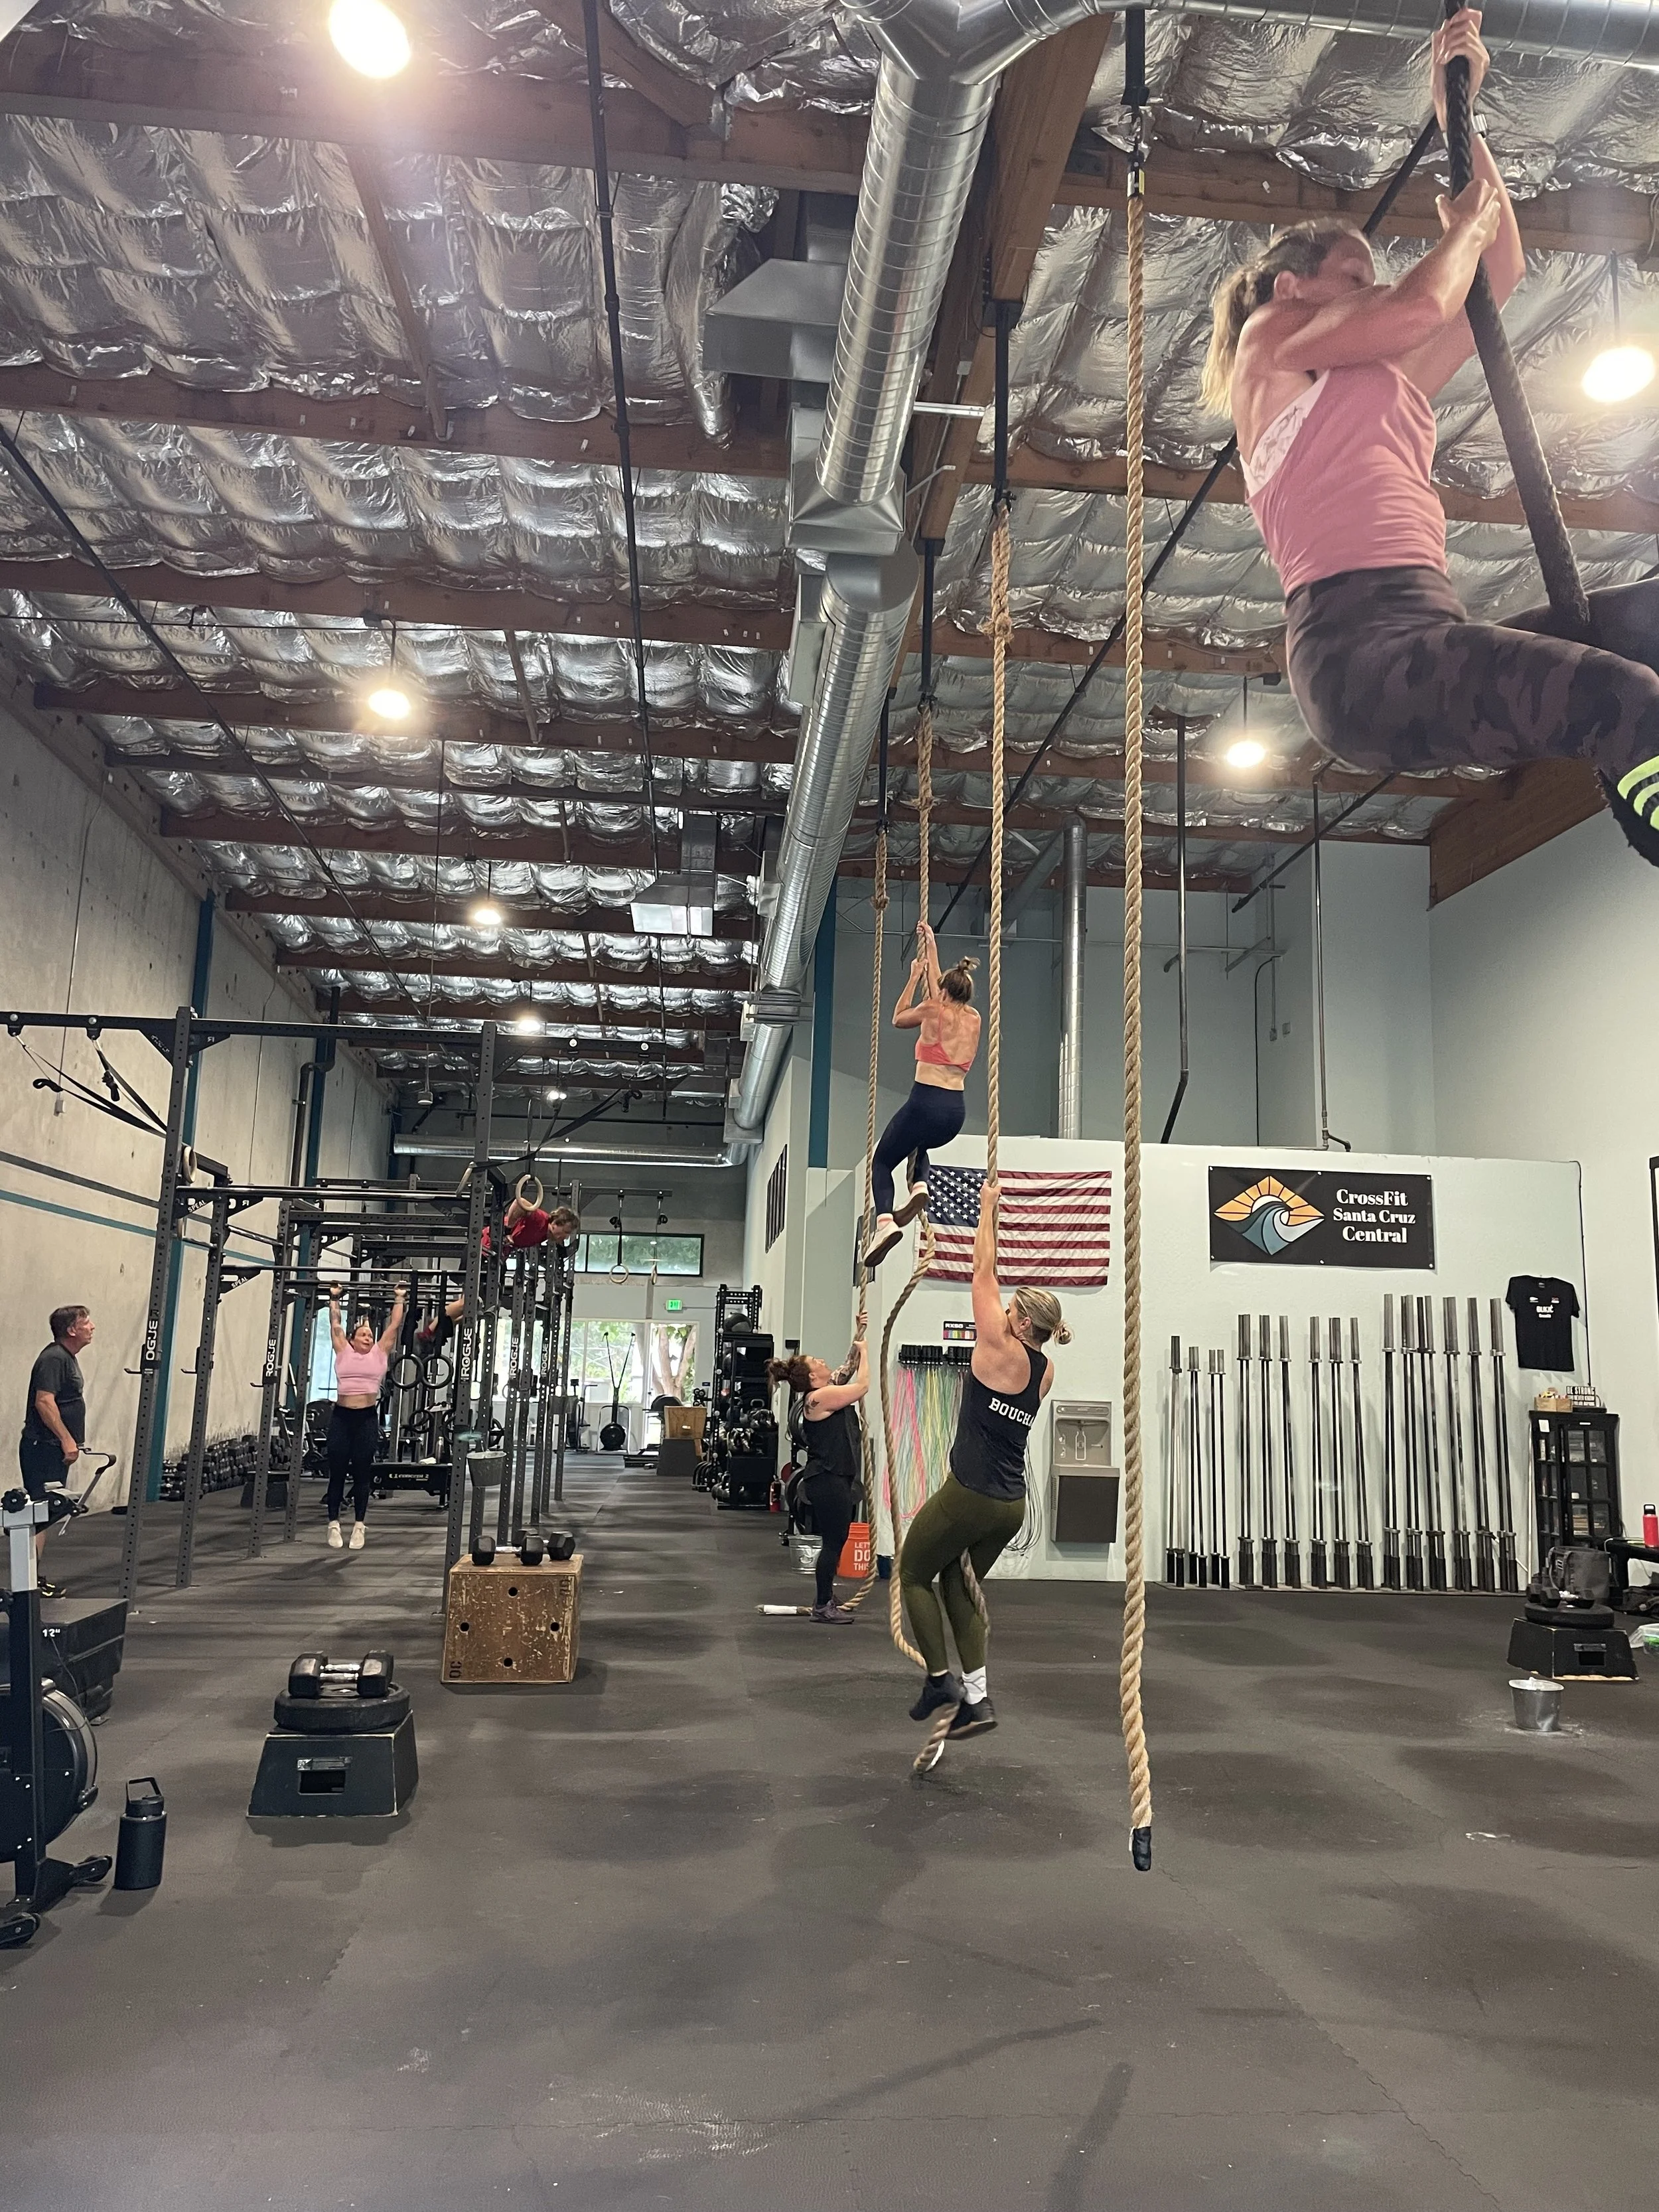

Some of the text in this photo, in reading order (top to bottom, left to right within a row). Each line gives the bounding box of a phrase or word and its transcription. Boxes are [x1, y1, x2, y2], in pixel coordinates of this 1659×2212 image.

[188, 1200, 207, 1213] SPEAL
[1336, 1189, 1408, 1207] CrossFit
[1333, 1207, 1416, 1224] Santa Cruz
[1342, 1226, 1407, 1243] Central
[232, 1276, 248, 1288] SPEAL
[145, 1321, 158, 1374] OGUE
[461, 1328, 472, 1380] ROGUE
[266, 1339, 276, 1376] ROGUE
[509, 1337, 519, 1378] ROGUE
[854, 1549, 871, 1562] DO
[42, 1629, 60, 1637] 12"
